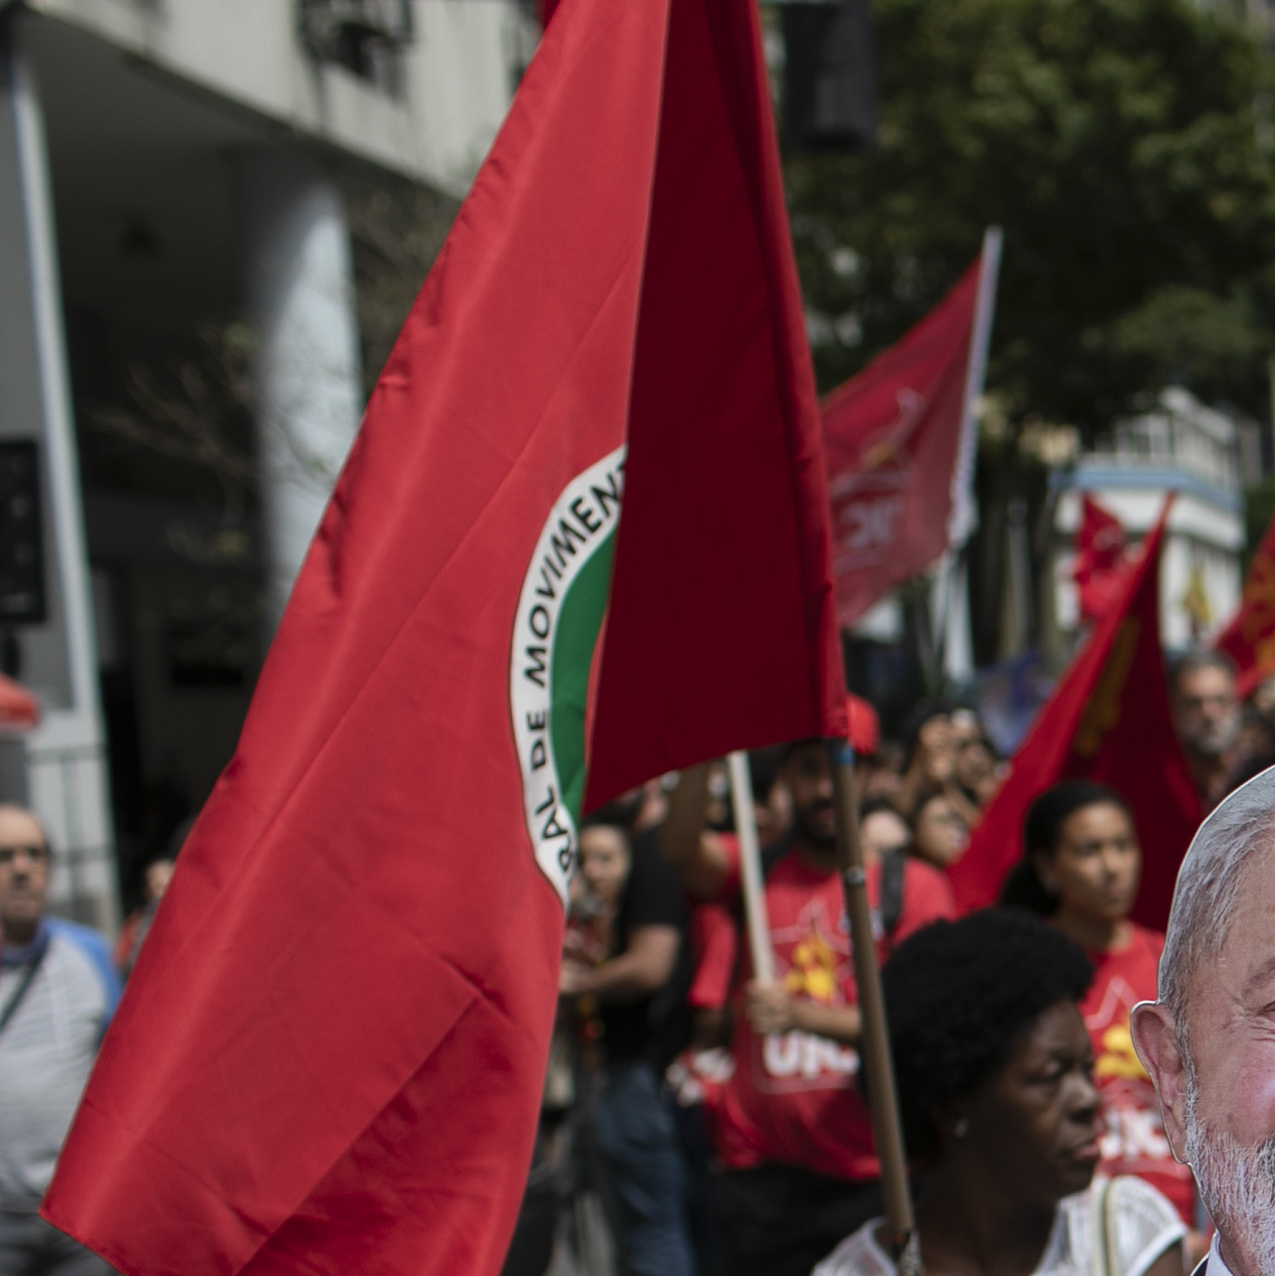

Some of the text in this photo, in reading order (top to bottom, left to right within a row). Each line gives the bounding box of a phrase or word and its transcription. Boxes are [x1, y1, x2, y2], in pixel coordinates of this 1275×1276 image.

[524, 461, 628, 875] RAL DE MOVIMEN
